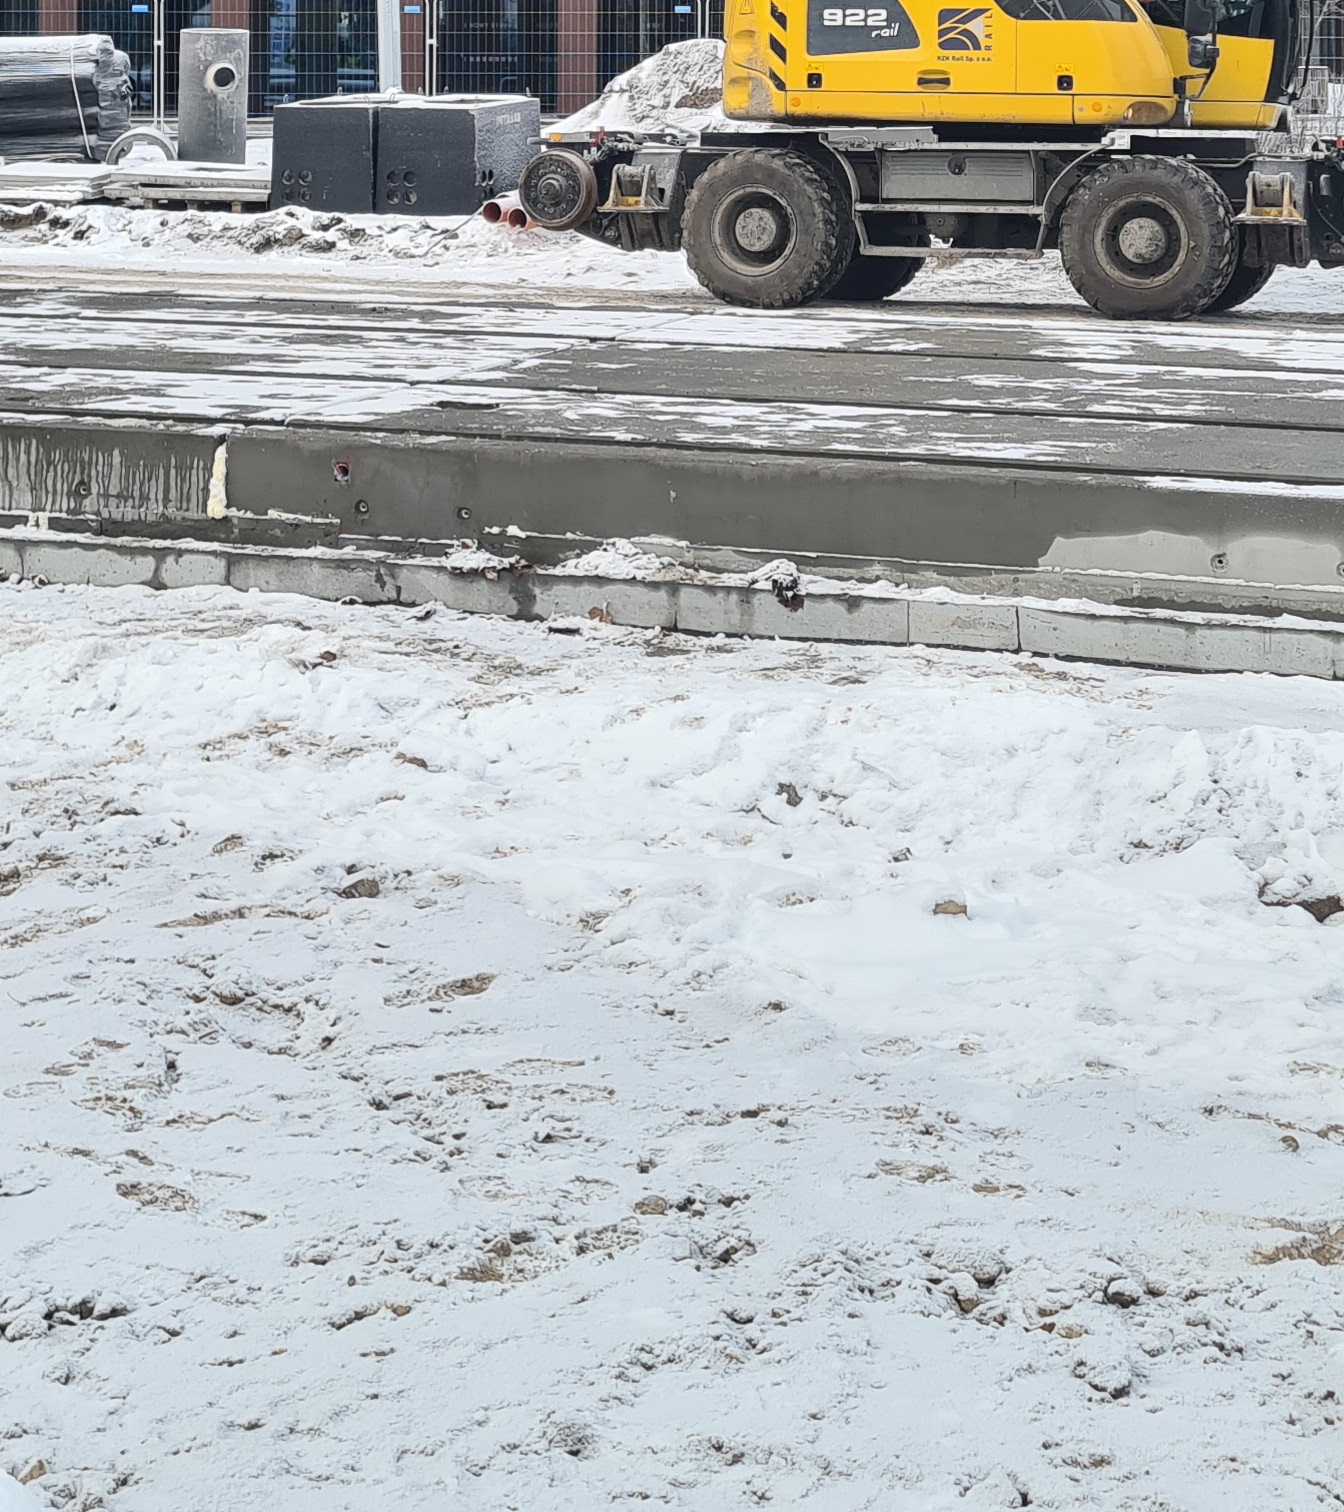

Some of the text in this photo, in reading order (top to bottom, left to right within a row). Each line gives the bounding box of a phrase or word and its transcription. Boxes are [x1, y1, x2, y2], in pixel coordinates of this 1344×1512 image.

[823, 8, 887, 26] 922
[871, 22, 900, 38] rail
[984, 13, 993, 51] RAIL
